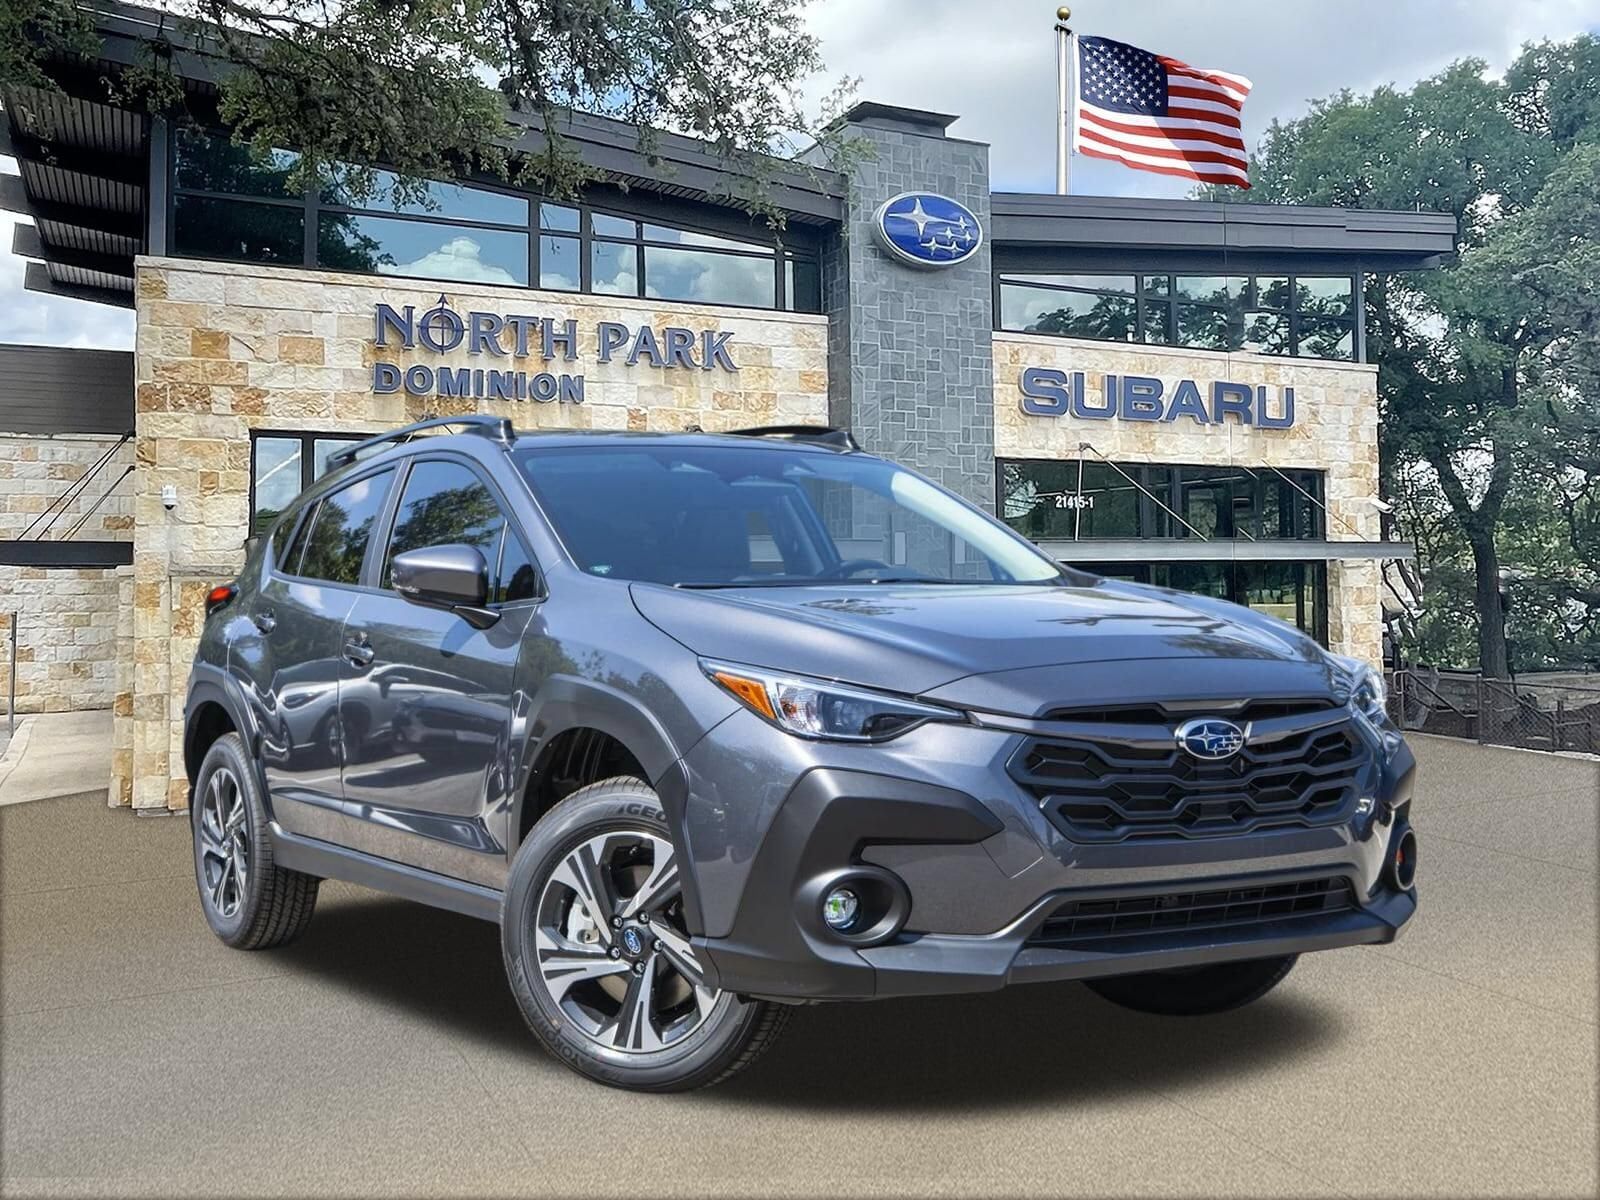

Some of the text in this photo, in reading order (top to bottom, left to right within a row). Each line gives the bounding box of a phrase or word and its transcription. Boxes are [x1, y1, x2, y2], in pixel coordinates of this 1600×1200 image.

[374, 294, 740, 372] NORTH PARK
[373, 362, 585, 404] DOMINION
[1019, 367, 1295, 430] SUBARU
[1055, 495, 1094, 509] 21415-1
